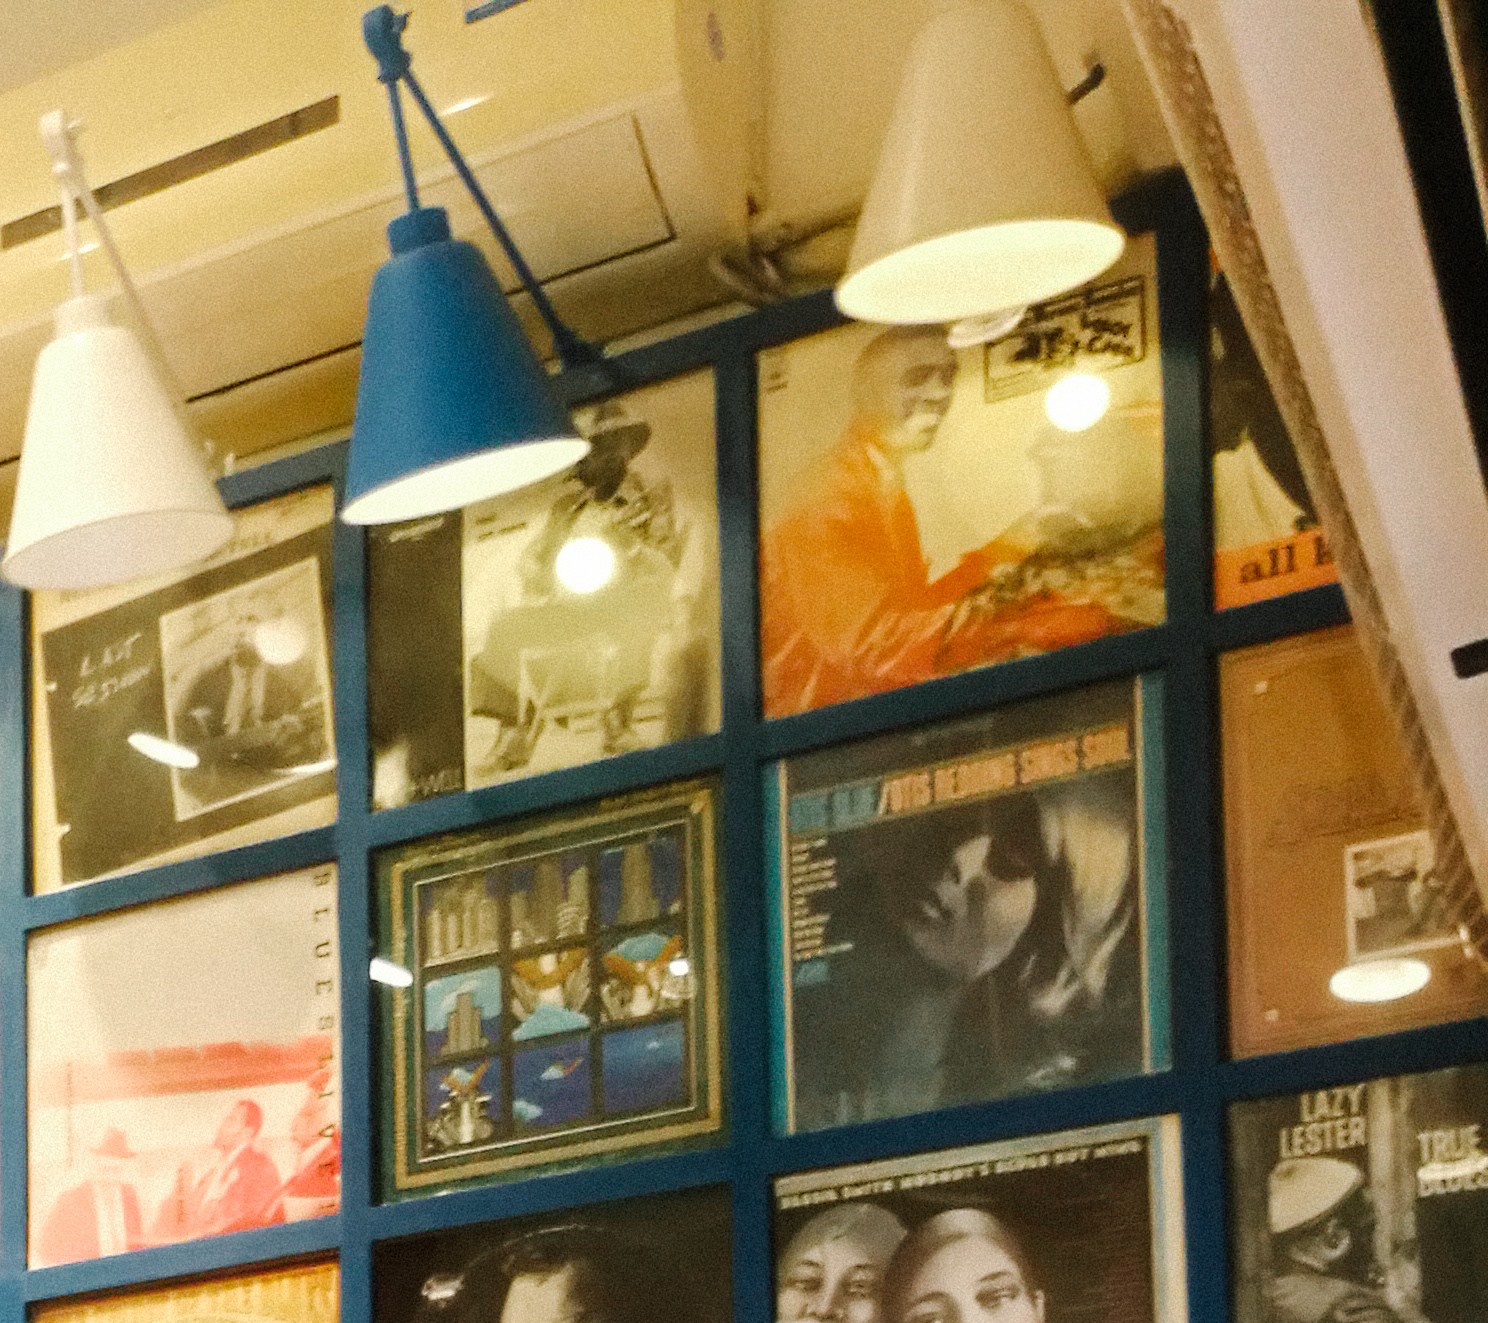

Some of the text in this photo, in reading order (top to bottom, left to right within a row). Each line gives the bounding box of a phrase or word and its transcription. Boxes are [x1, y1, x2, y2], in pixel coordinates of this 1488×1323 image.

[1299, 1082, 1367, 1122] LAZY
[1278, 1116, 1368, 1158] LESTER
[1417, 1123, 1481, 1162] TRUE
